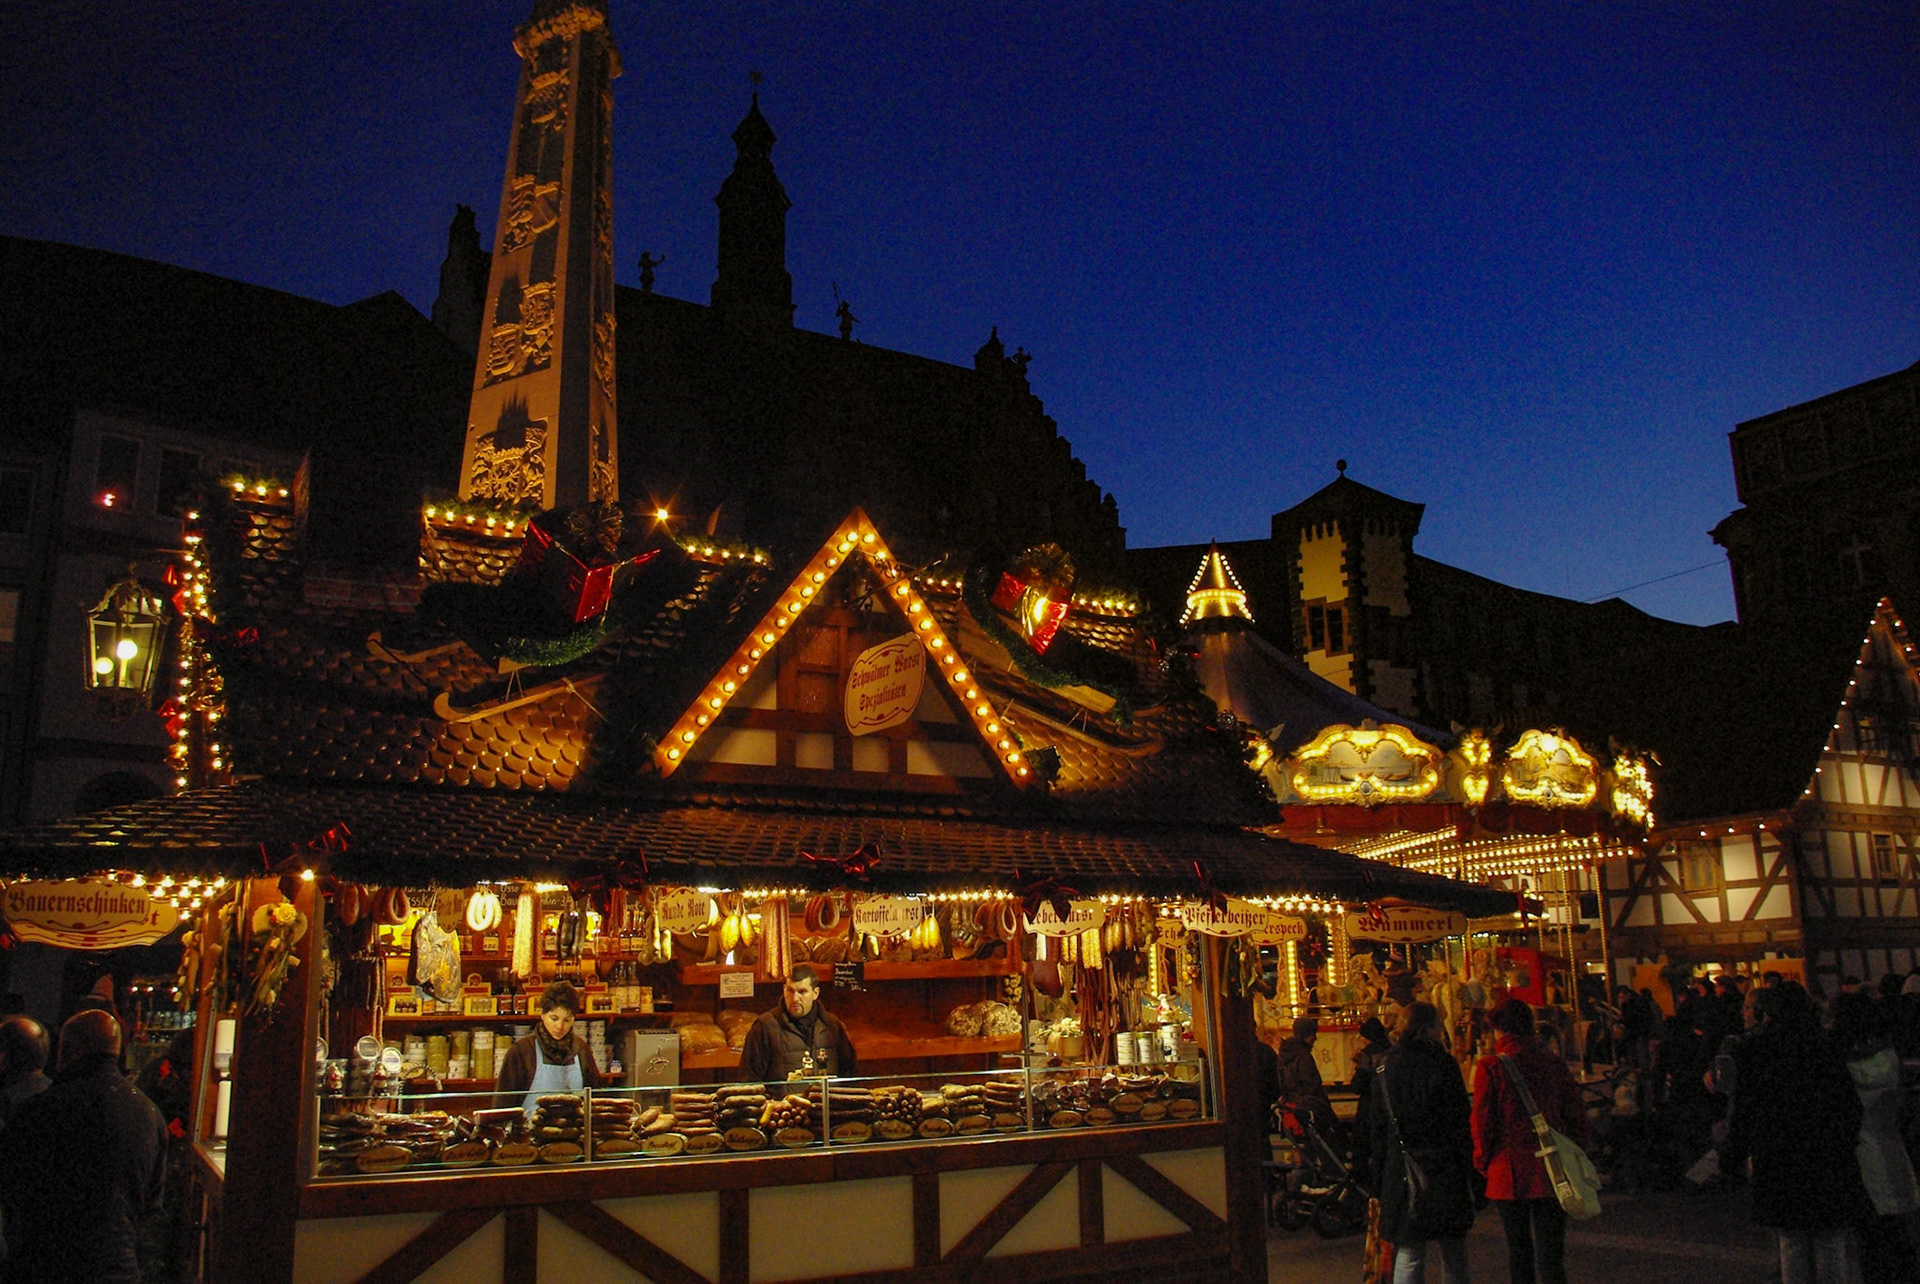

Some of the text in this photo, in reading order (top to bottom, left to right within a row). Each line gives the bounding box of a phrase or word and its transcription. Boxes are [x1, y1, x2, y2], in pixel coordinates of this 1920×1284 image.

[8, 889, 145, 918] Bauernschinken
[1031, 908, 1093, 925] eberurst
[1185, 907, 1265, 928] Pfeferbeißer
